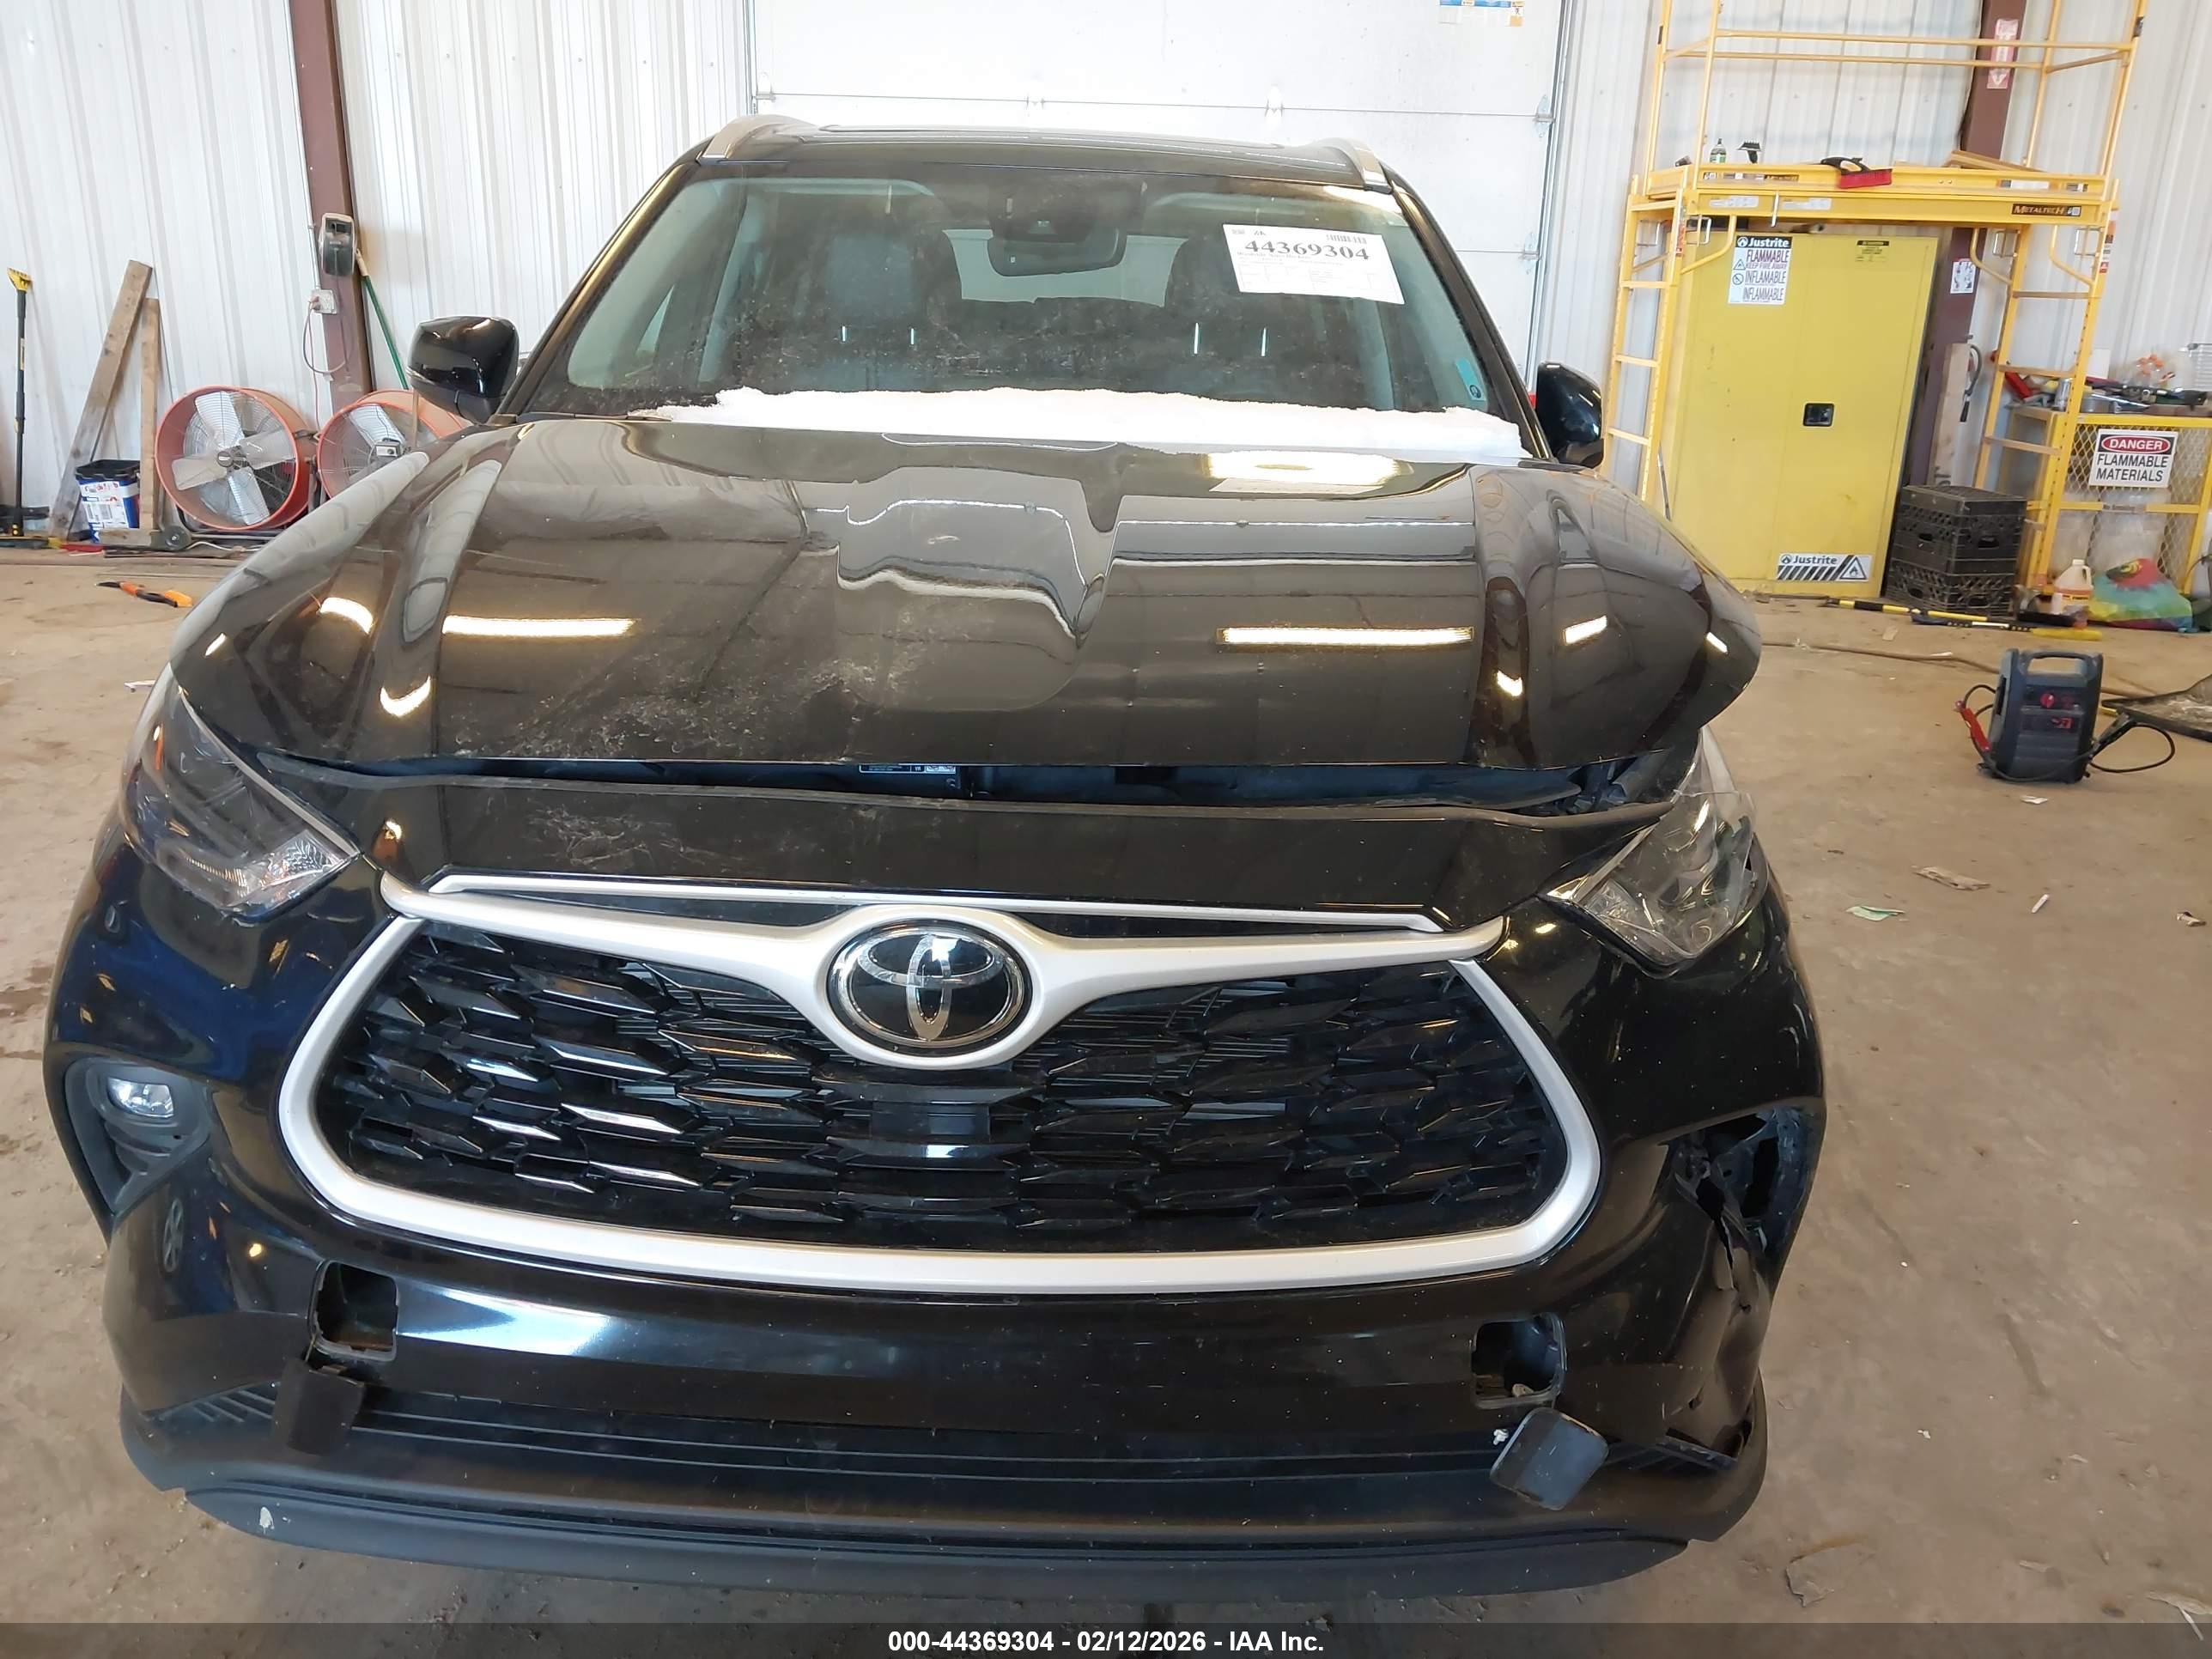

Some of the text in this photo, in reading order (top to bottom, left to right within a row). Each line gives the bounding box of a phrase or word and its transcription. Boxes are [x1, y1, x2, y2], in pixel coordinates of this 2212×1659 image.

[1748, 237, 1790, 247] Justrite
[1245, 240, 1369, 260] 44369304
[1747, 249, 1790, 262] FLAMMABLE
[1745, 270, 1786, 283] INFLAMABLE
[2109, 439, 2163, 450] DANGER
[2097, 454, 2168, 467] FLAMMABLE
[2096, 469, 2162, 482] MATERIALS
[1794, 556, 1838, 564] Justrite
